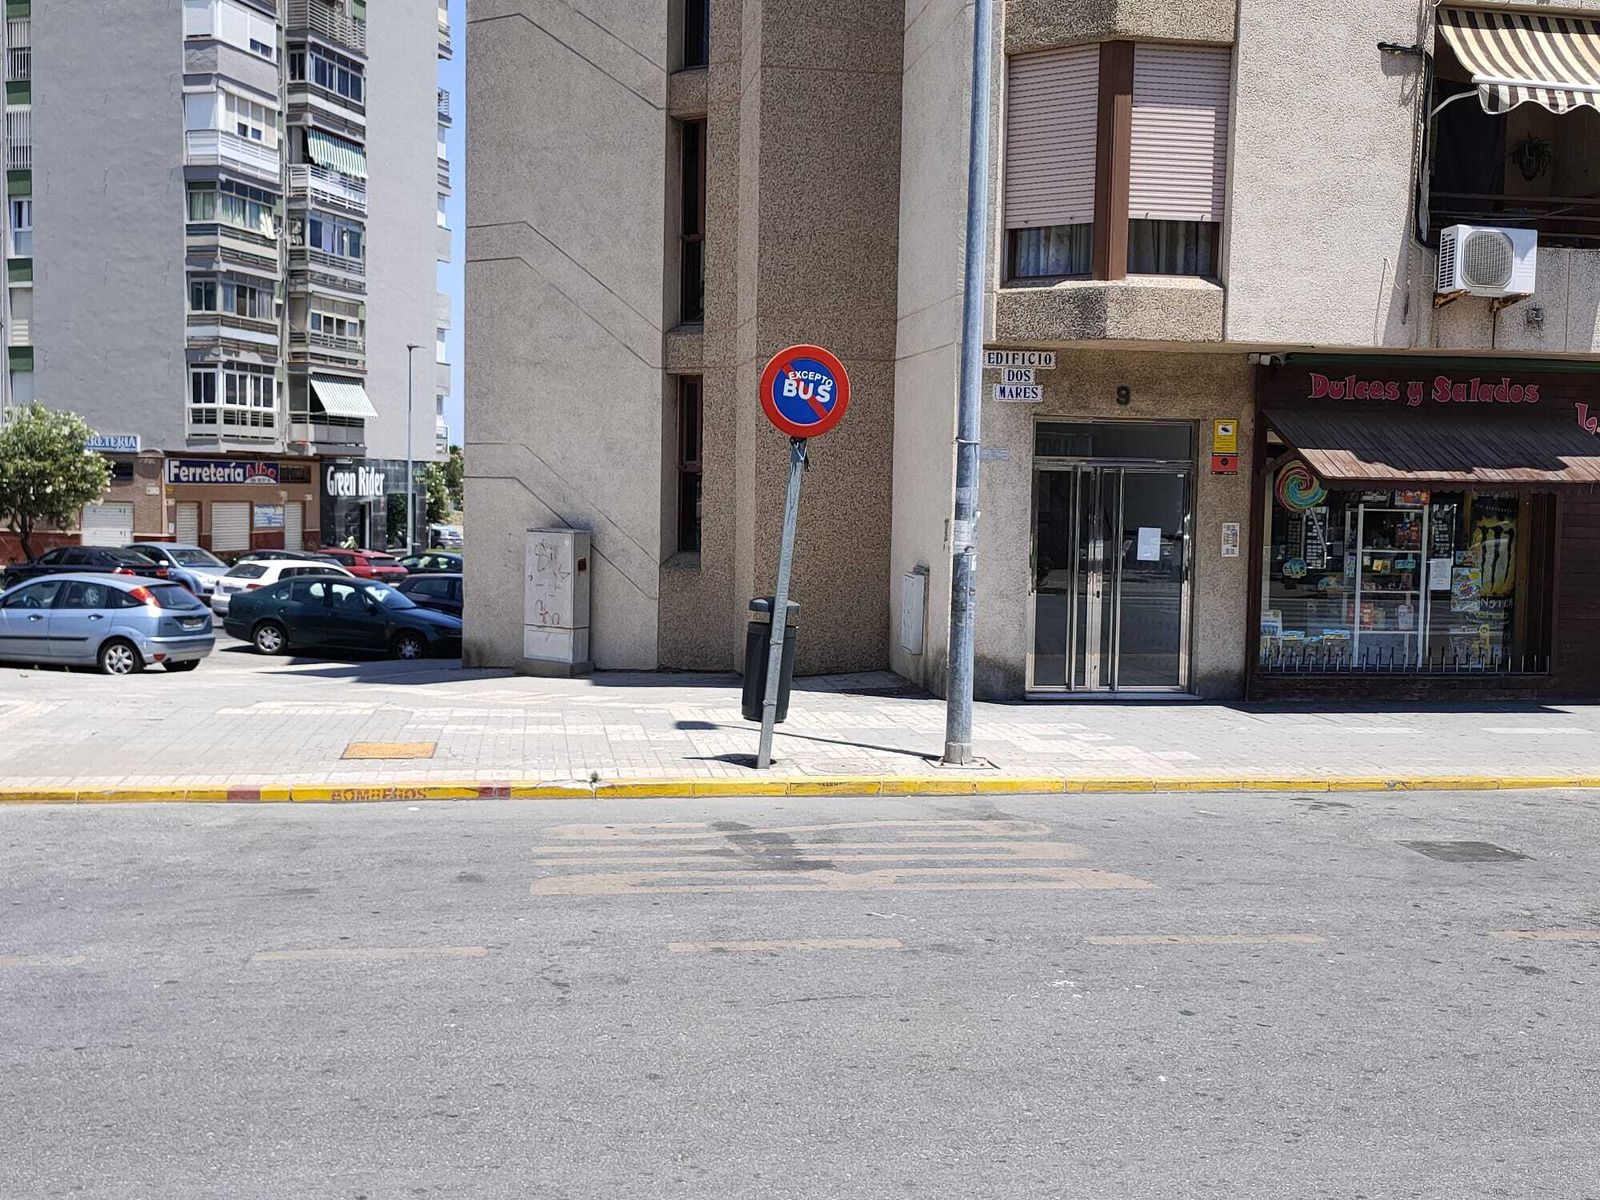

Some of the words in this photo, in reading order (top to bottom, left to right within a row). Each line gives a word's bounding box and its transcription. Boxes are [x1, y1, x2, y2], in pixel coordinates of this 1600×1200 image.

[987, 351, 1052, 366] EDIFICIO
[788, 370, 833, 387] EXCEPTO
[1007, 369, 1031, 382] DOS
[782, 378, 832, 403] BUS
[999, 386, 1039, 399] MARES
[1307, 372, 1400, 400] Dulces
[1407, 381, 1424, 406] y
[1432, 375, 1540, 403] Salados
[169, 460, 244, 482] Ferretería
[246, 462, 277, 478] Alba
[327, 465, 356, 496] Green
[358, 465, 385, 496] Rider
